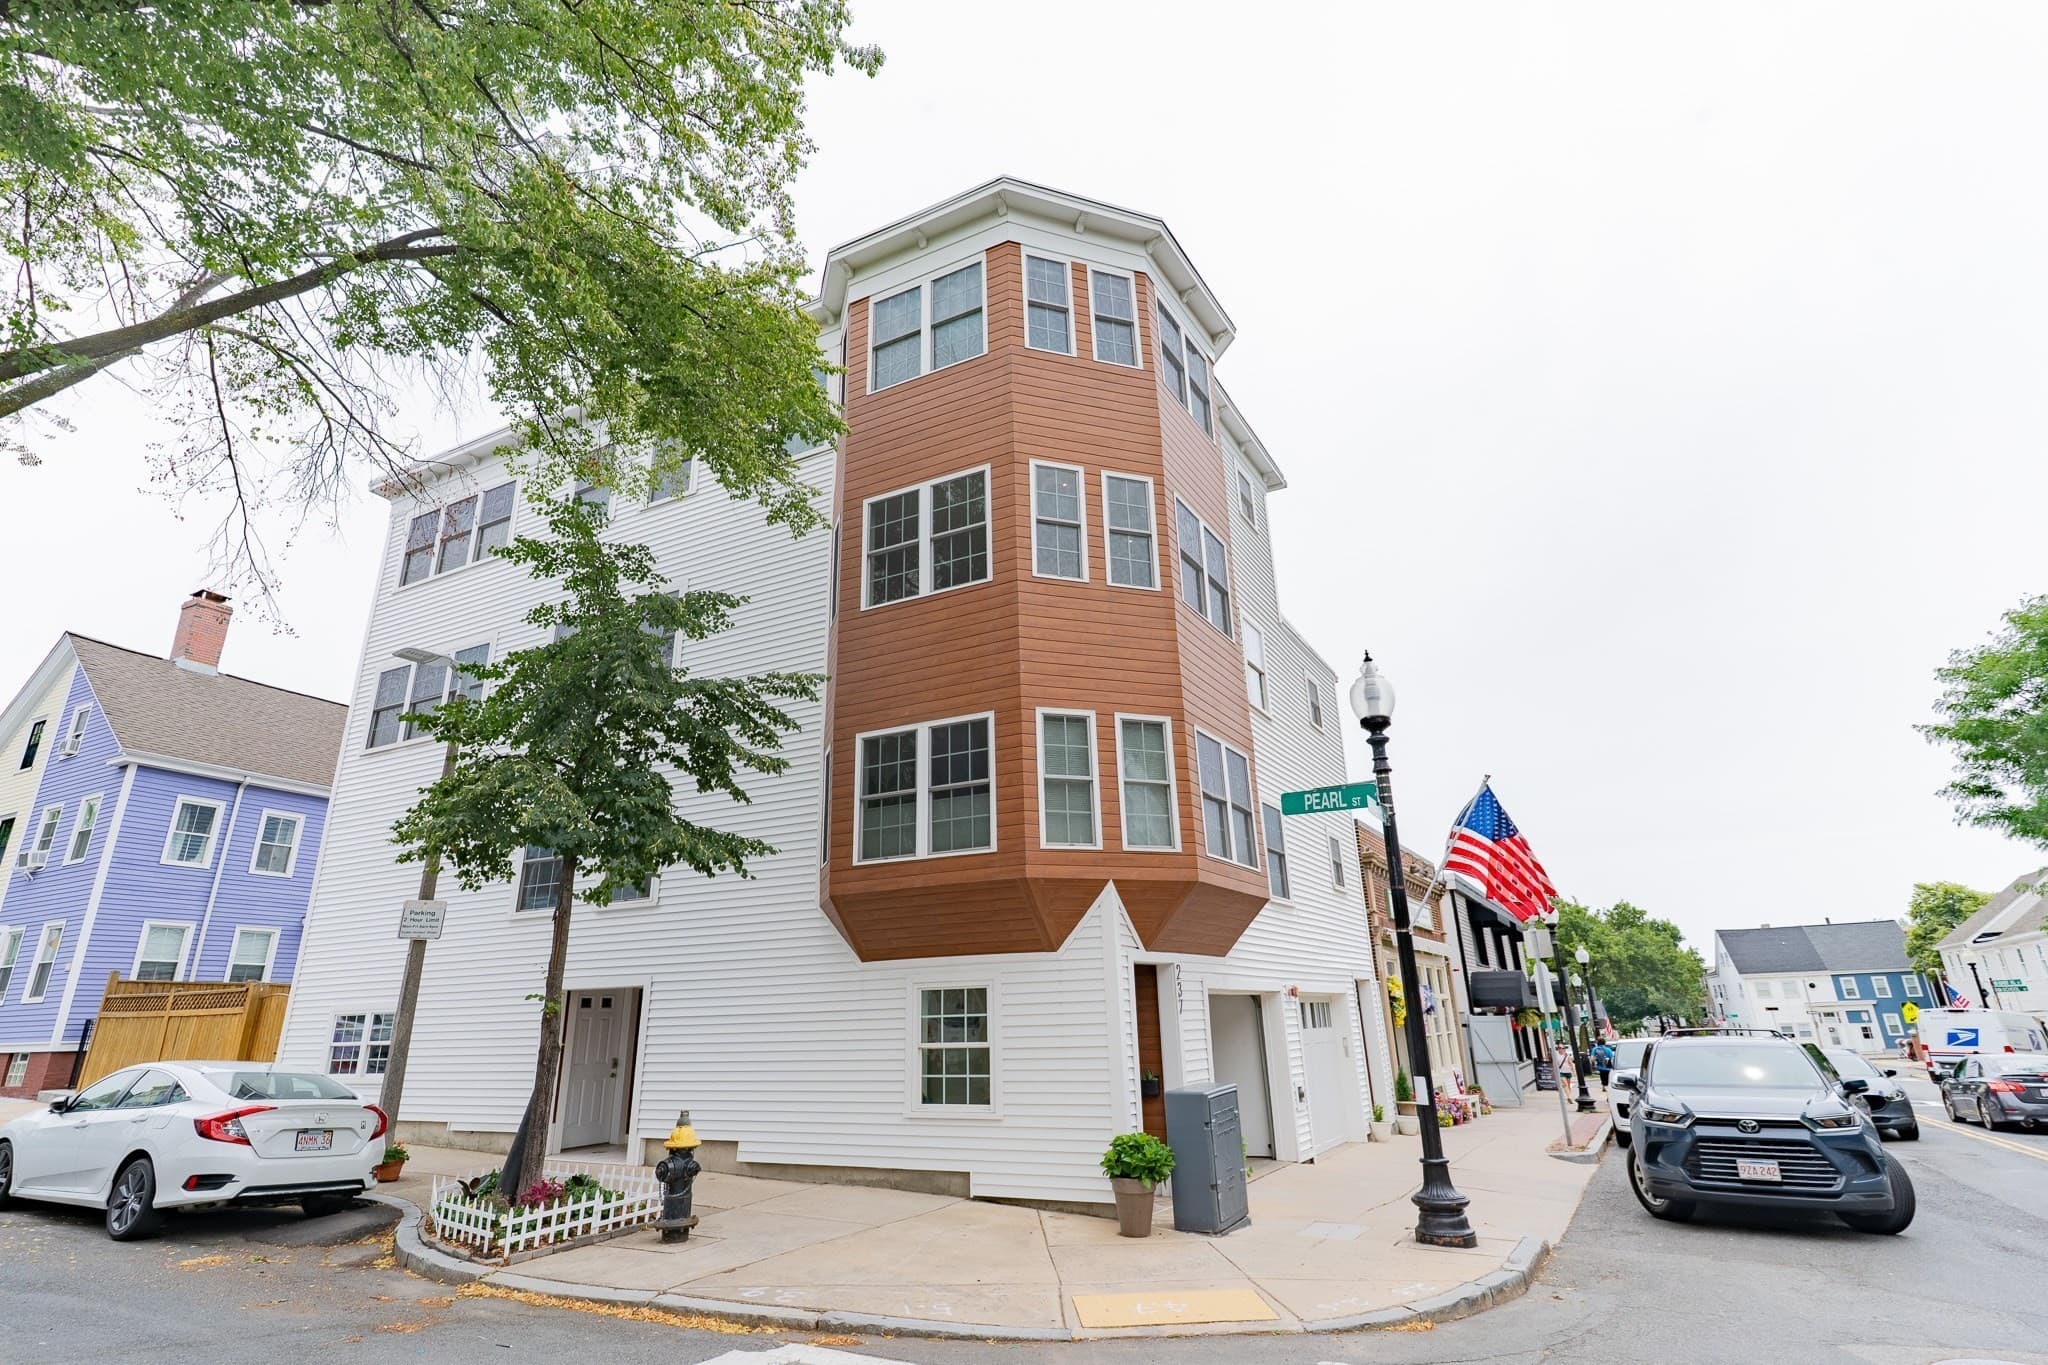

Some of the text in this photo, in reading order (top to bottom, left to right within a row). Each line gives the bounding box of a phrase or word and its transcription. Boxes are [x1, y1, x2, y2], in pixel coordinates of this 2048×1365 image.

[1304, 791, 1361, 810] PEARL ST
[409, 909, 436, 917] Parking
[1760, 1167, 1778, 1176] 242
